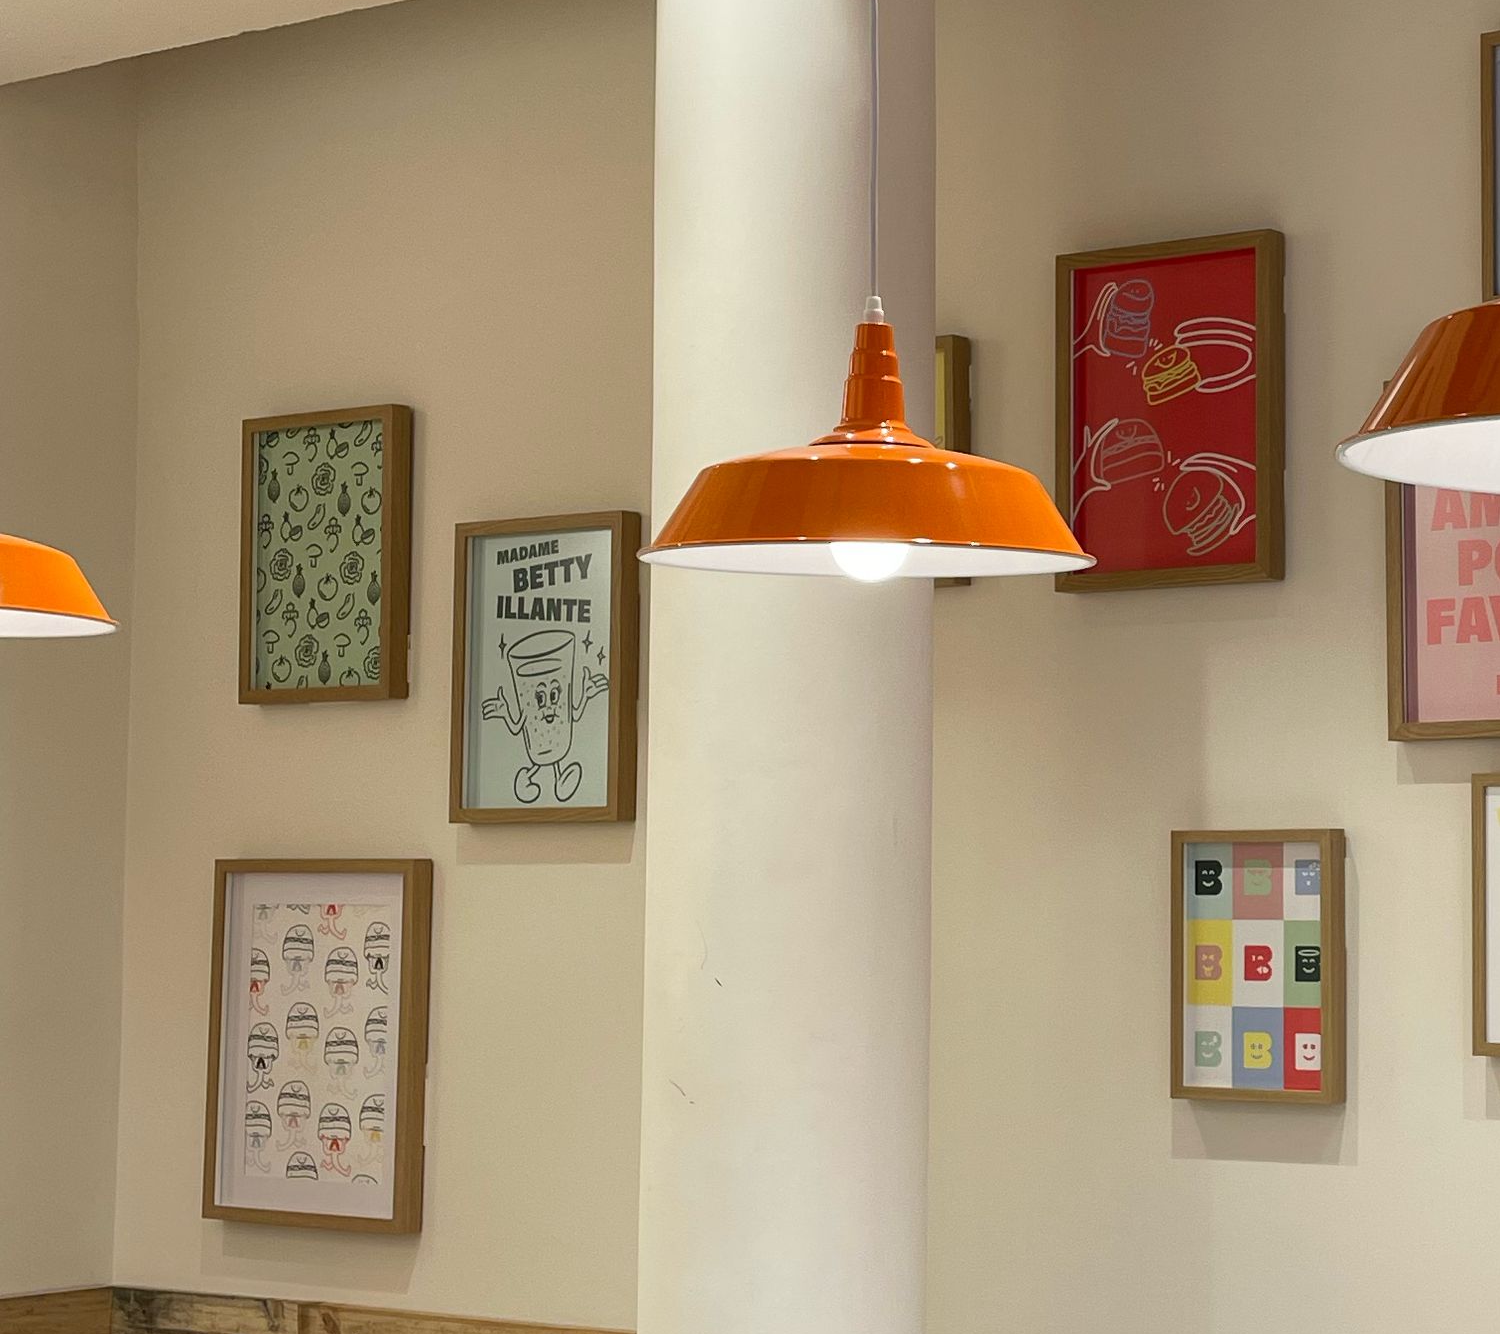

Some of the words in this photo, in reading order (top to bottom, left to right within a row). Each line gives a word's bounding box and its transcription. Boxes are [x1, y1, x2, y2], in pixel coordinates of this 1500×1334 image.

[497, 539, 559, 565] MADAME
[513, 553, 592, 593] BETTY
[496, 595, 592, 623] ILLANTE
